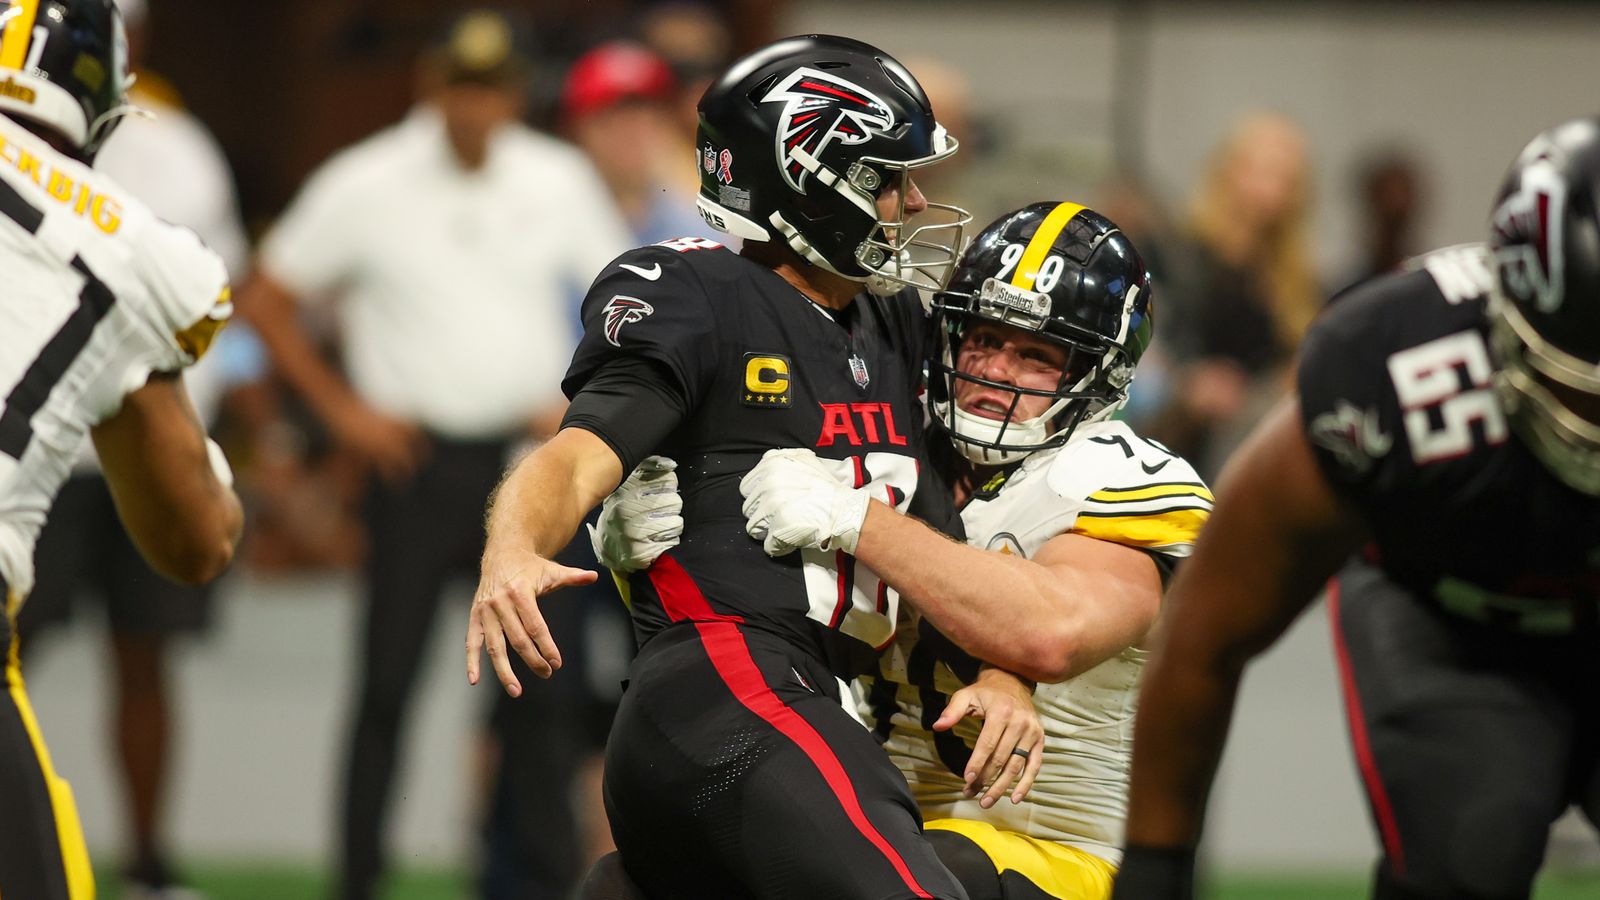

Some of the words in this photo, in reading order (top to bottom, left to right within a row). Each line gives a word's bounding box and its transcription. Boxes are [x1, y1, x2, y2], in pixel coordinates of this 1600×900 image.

[993, 243, 1064, 293] 90
[998, 287, 1034, 310] Steelers
[745, 357, 789, 394] C
[1388, 329, 1508, 464] 65
[816, 401, 908, 447] ATL
